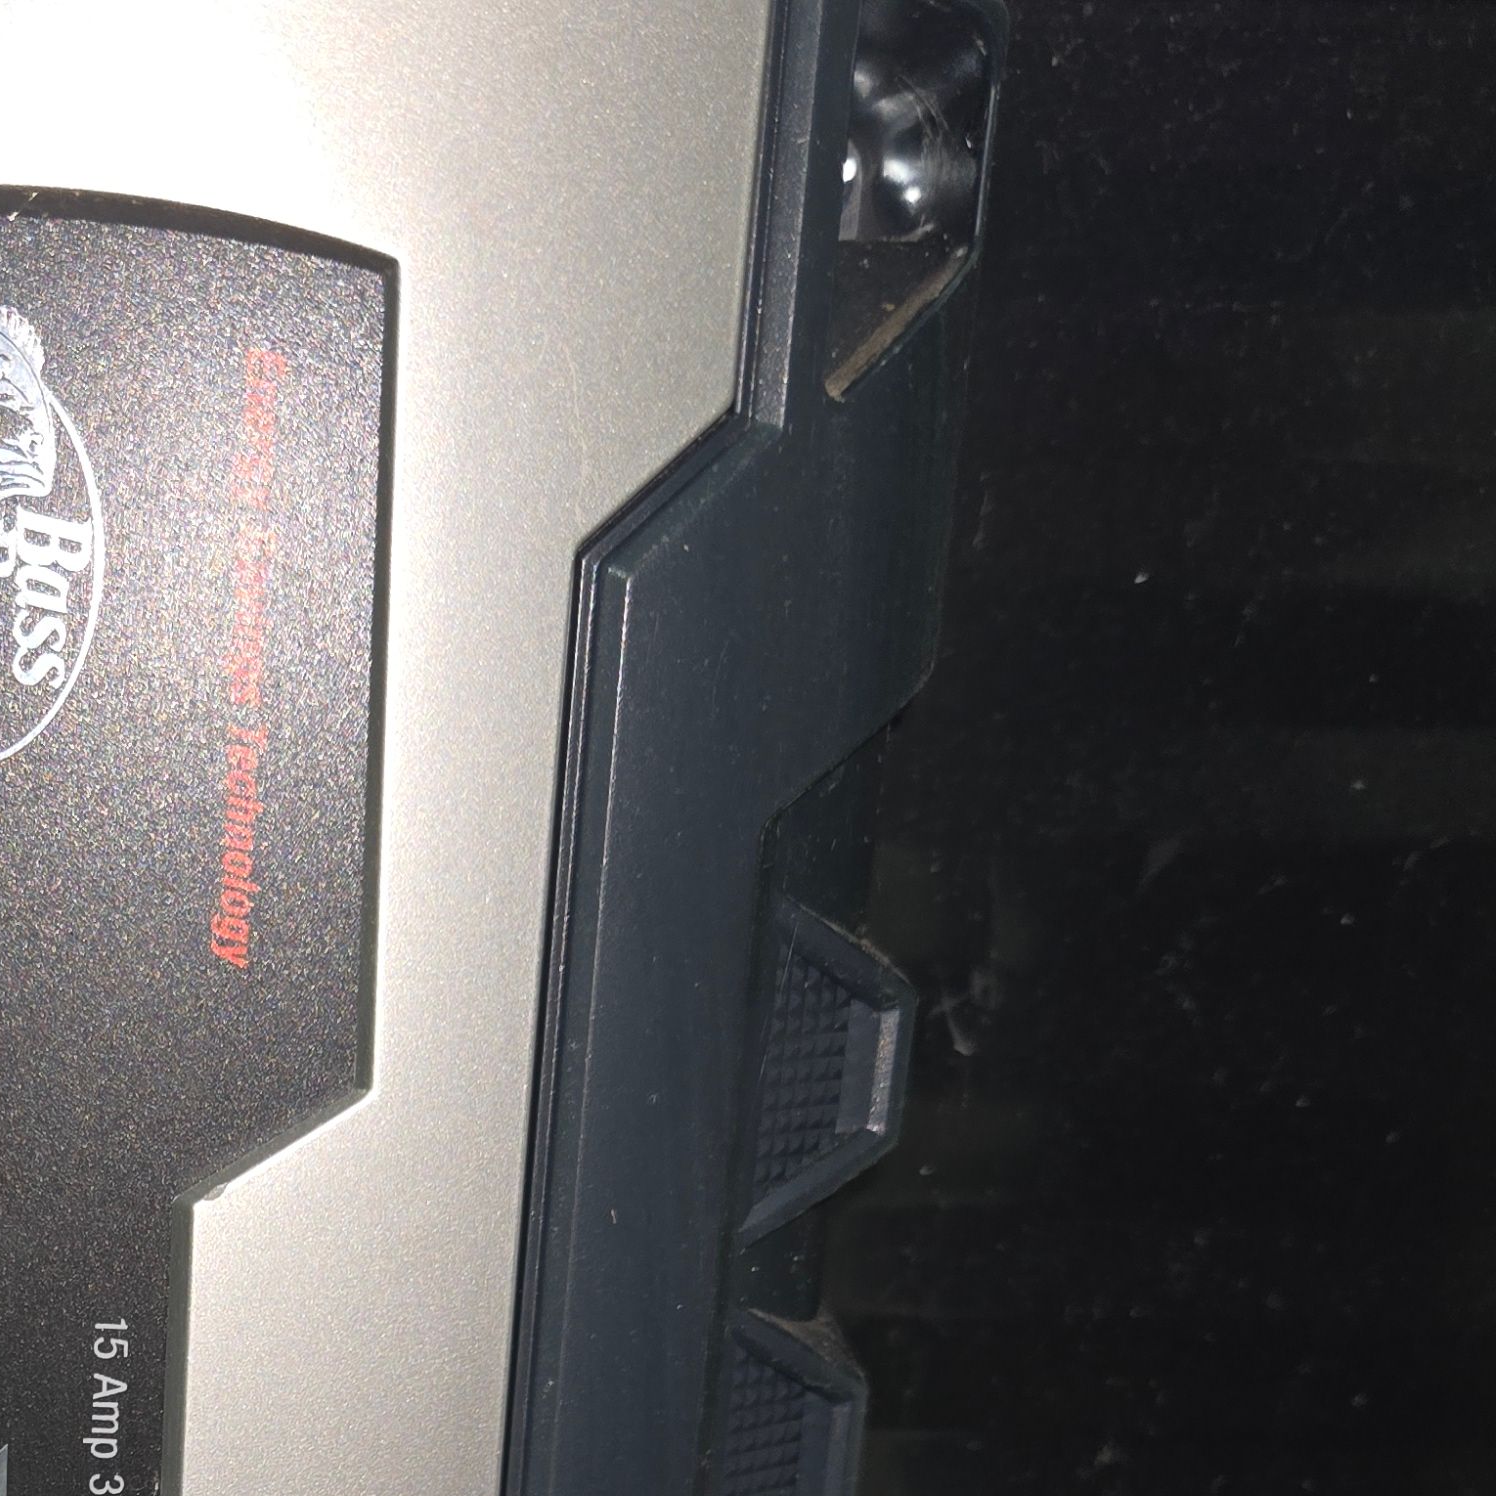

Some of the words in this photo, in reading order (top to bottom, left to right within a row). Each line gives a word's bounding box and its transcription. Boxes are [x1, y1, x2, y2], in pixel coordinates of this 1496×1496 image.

[12, 507, 93, 688] Bass
[210, 724, 269, 969] Technology
[92, 1317, 129, 1360] 15
[82, 1373, 126, 1461] Amp
[90, 1473, 125, 1496] 3
